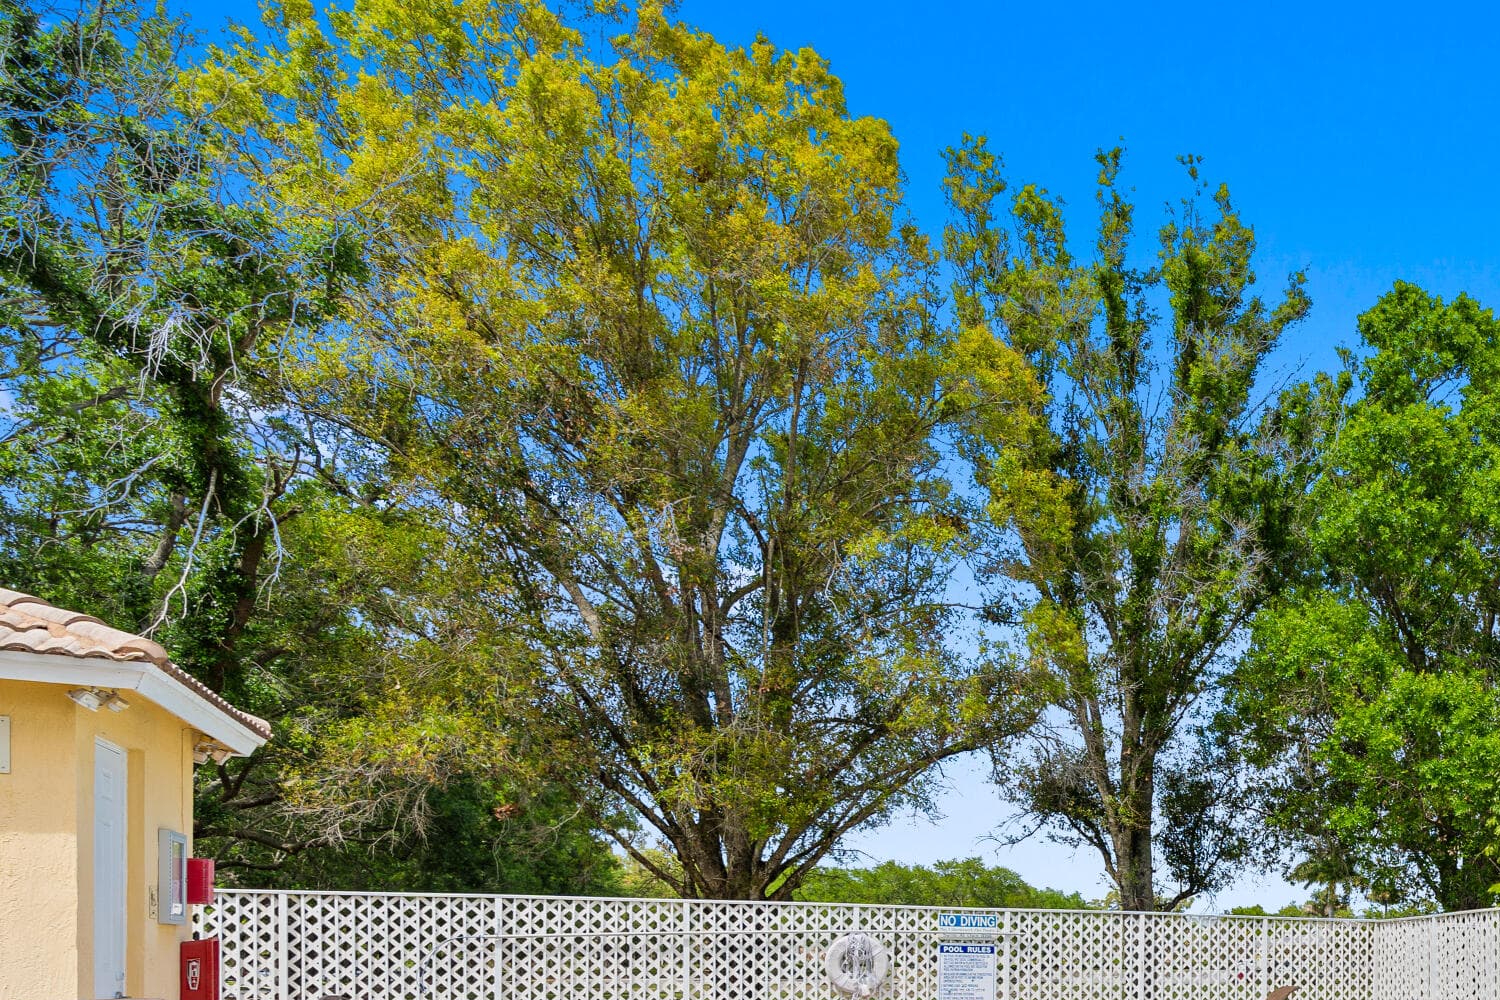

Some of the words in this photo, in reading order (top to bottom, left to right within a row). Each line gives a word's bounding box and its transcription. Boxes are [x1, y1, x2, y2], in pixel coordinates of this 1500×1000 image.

[940, 914, 957, 926] NO
[960, 915, 996, 927] DIVING
[967, 946, 992, 954] RULES
